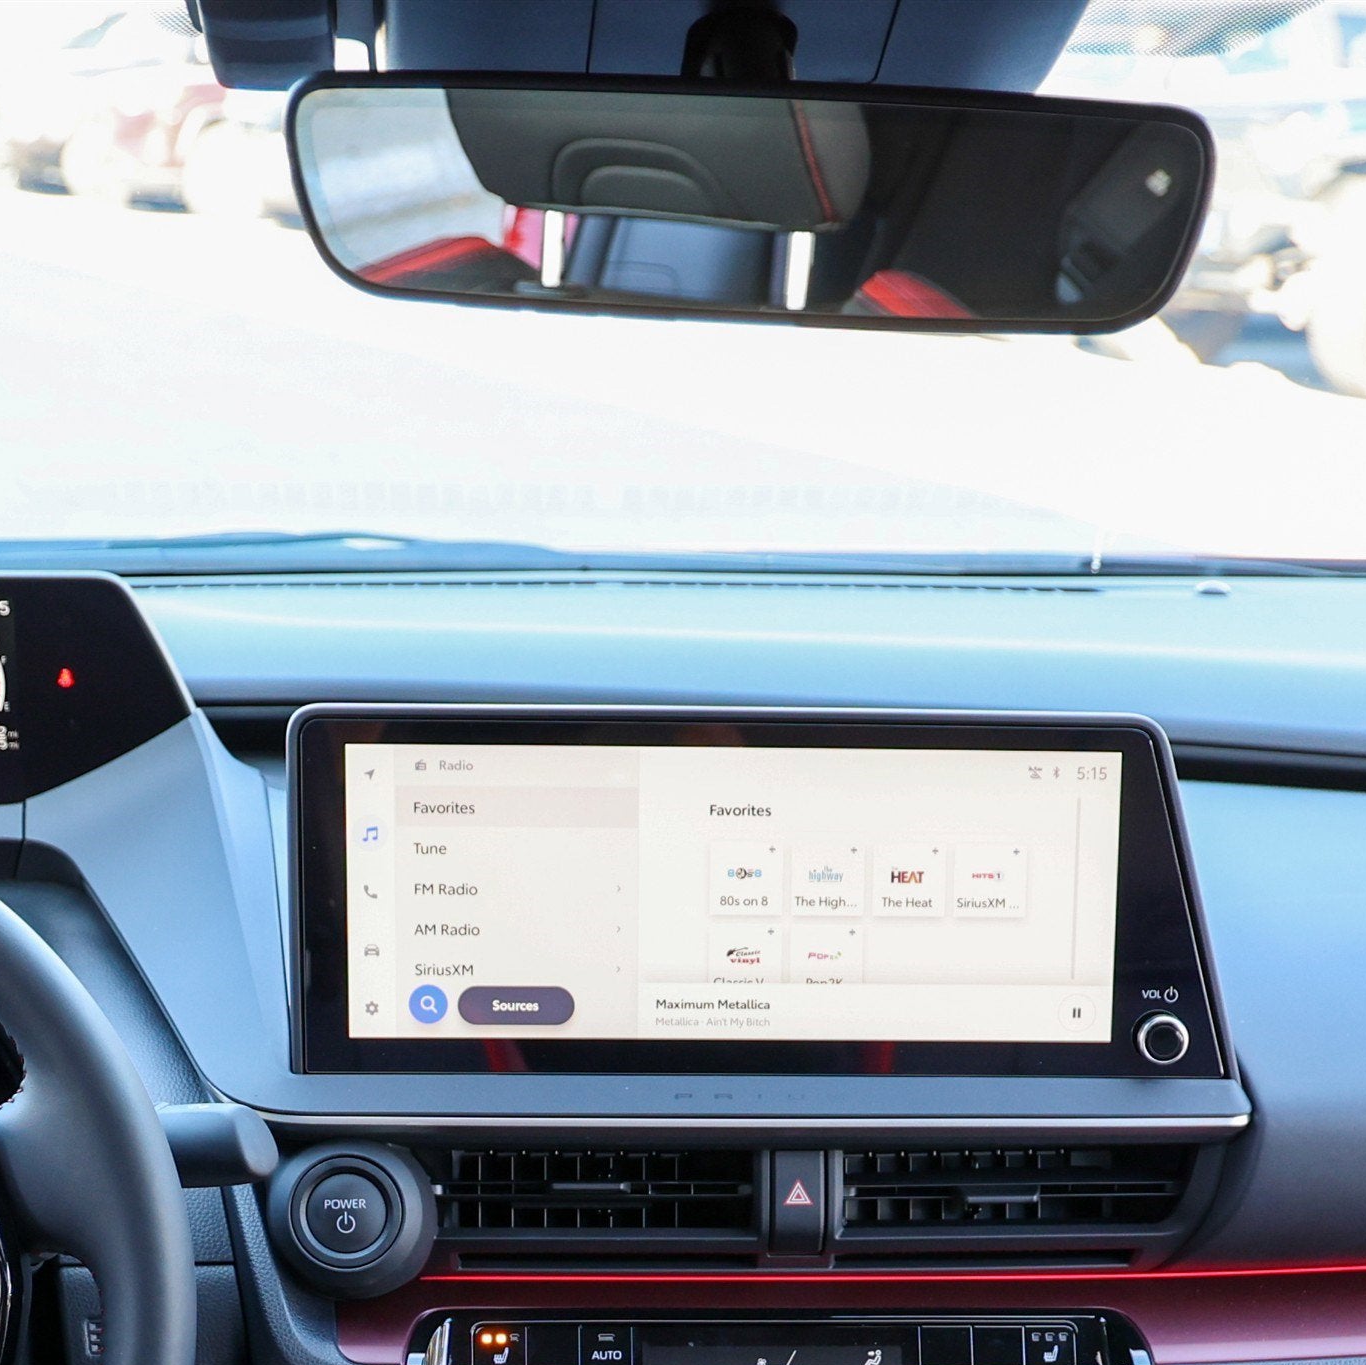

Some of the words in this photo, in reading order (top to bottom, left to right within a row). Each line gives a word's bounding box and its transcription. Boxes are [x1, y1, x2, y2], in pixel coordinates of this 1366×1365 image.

[438, 759, 474, 772] Radio
[1076, 766, 1108, 781] 5:15
[412, 801, 476, 815] Favorites
[709, 803, 772, 817] Favorites
[413, 842, 447, 855] Tune
[808, 868, 844, 883] highway
[890, 870, 925, 884] HEAT
[414, 883, 434, 896] FM
[438, 883, 478, 896] Radio
[719, 895, 741, 907] 80s
[742, 897, 758, 906] on
[761, 895, 769, 907] 8
[794, 895, 816, 907] The
[881, 897, 903, 909] The
[905, 897, 933, 909] Heat
[956, 897, 1006, 909] SiriusXM
[414, 924, 437, 937] AM
[440, 923, 481, 937] Radio
[729, 956, 761, 965] vinyl
[414, 962, 475, 976] SiriusXM
[1141, 989, 1162, 1000] VOL
[491, 999, 539, 1012] Sources
[655, 998, 715, 1011] Maximum
[717, 998, 771, 1011] Metallica
[655, 1017, 700, 1027] Metallica
[706, 1017, 728, 1027] Ain't
[730, 1017, 745, 1029] My
[746, 1017, 771, 1028] Bitch
[323, 1198, 367, 1210] POWER
[591, 1349, 623, 1362] AUTO
